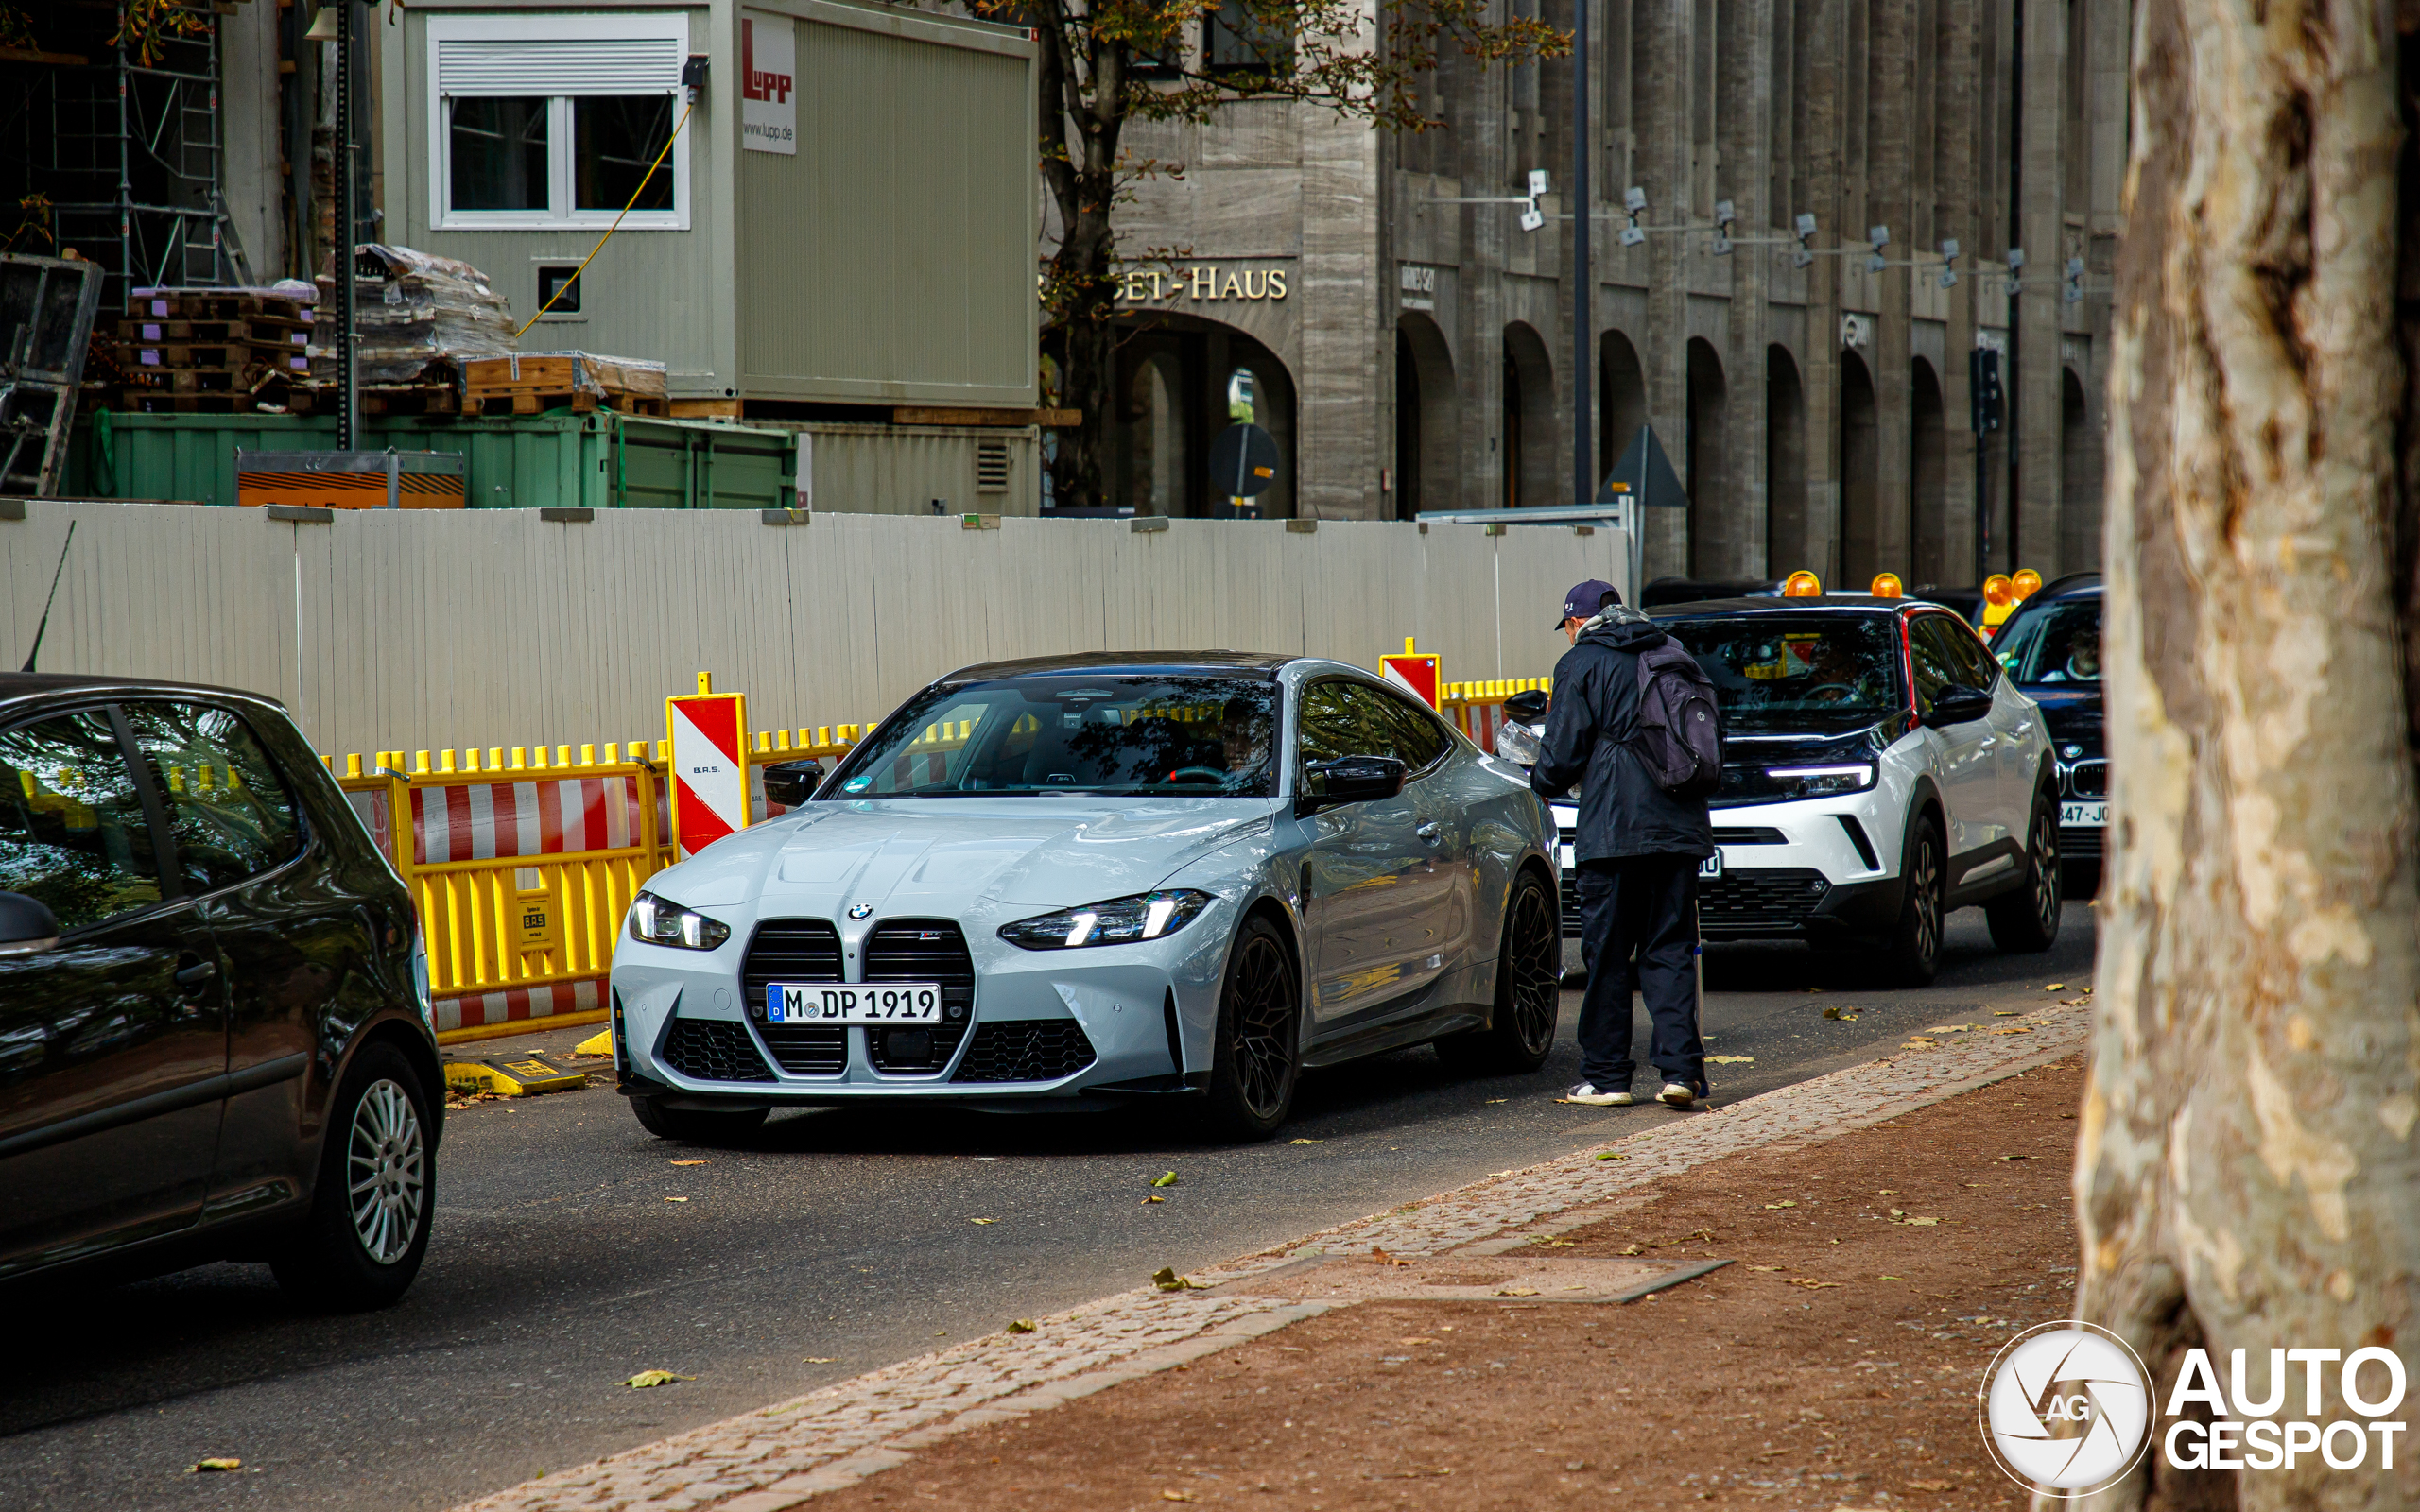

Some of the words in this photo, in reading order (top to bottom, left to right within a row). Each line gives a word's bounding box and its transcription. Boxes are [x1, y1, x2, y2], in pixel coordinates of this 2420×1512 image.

[743, 122, 793, 141] www.lupp.de
[772, 1007, 780, 1016] D
[785, 990, 803, 1018] M
[821, 990, 857, 1018] DP
[864, 990, 935, 1018] 1919
